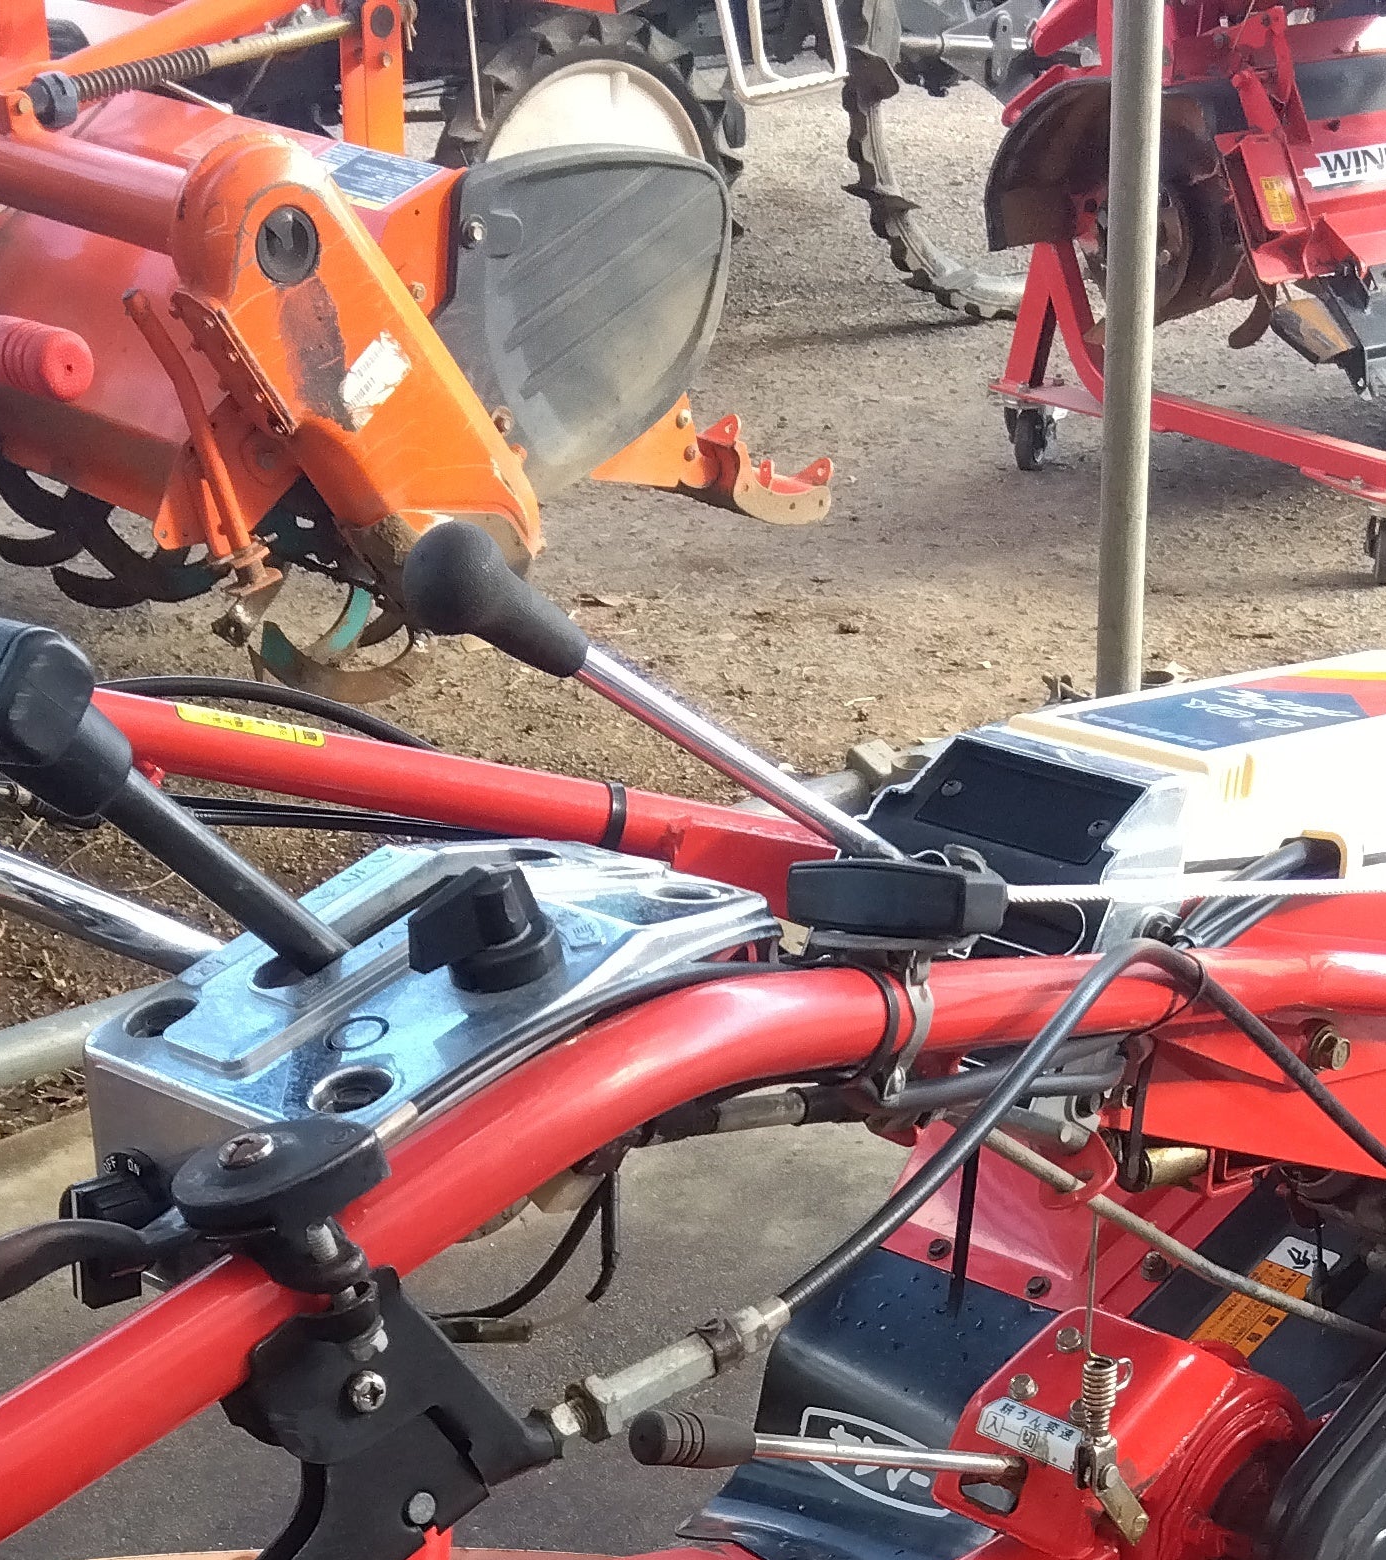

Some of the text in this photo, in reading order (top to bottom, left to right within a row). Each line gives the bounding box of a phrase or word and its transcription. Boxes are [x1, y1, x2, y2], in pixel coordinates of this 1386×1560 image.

[103, 1155, 141, 1176] OFF ON
[986, 1415, 1037, 1448] 入 切
[999, 1402, 1076, 1442] 耕うん変速
